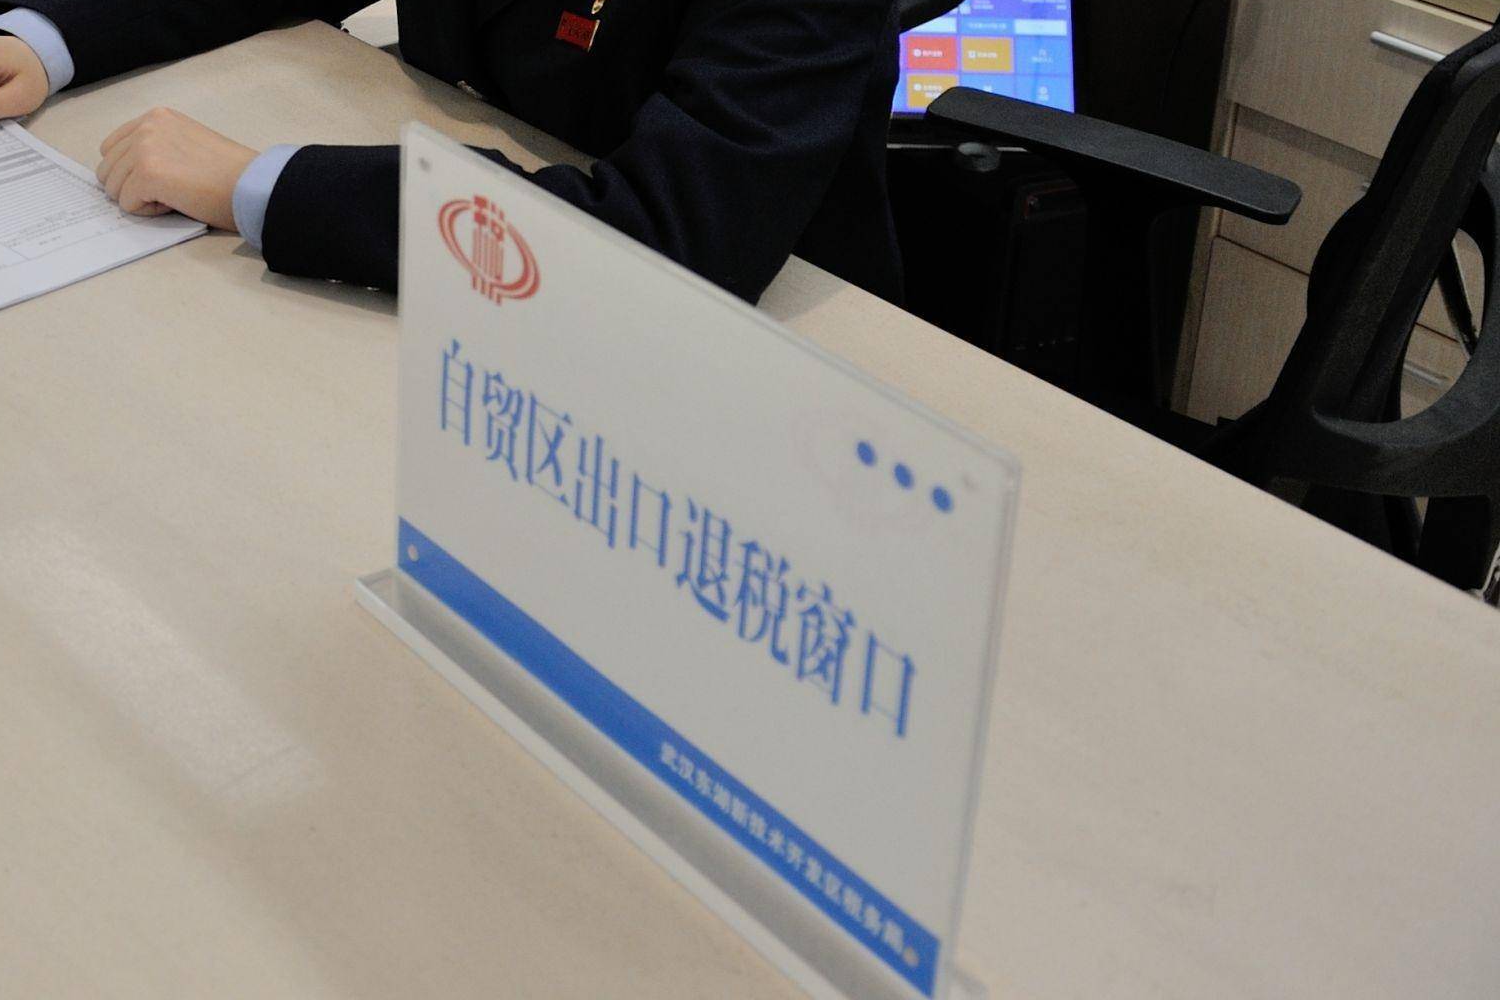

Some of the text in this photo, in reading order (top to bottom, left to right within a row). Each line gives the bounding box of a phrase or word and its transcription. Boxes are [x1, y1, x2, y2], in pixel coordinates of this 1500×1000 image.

[439, 338, 916, 739] 自贸区出口退税窗口
